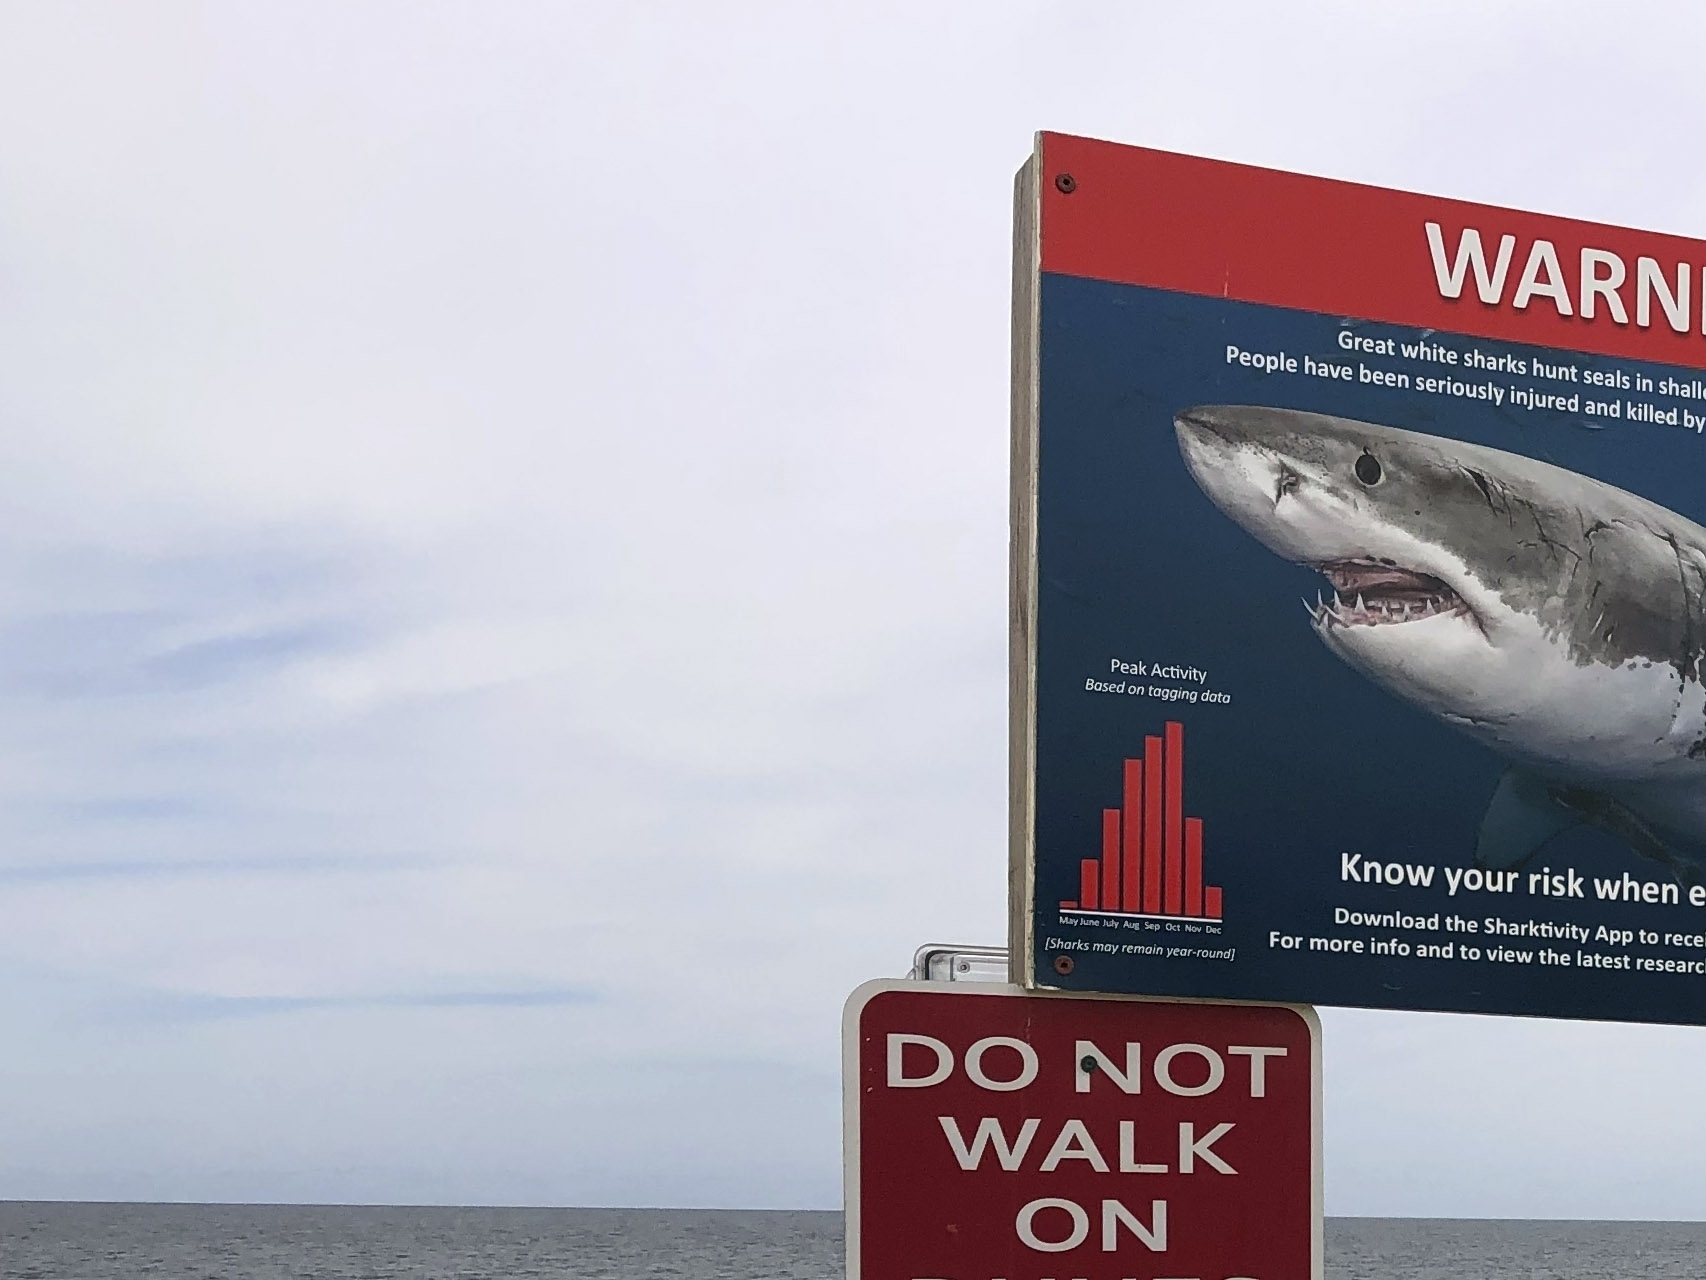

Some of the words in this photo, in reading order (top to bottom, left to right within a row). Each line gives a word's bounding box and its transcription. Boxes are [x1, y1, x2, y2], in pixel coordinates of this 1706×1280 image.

[1338, 330, 1395, 356] Great
[1400, 340, 1458, 364] white
[1464, 348, 1526, 375] sharks
[1532, 357, 1578, 382] hunt
[1583, 369, 1630, 389] seals
[1636, 373, 1653, 392] in
[1226, 345, 1297, 373] People
[1304, 355, 1352, 380] have
[1359, 363, 1409, 388] been
[1415, 375, 1505, 406] seriously
[1510, 385, 1578, 412] injured
[1584, 399, 1620, 418] and
[1627, 401, 1677, 425] killed
[1683, 408, 1706, 433] by
[1085, 678, 1125, 693] Based
[1127, 685, 1145, 695] on
[1148, 685, 1198, 703] tagging
[1200, 689, 1230, 703] data
[1111, 658, 1147, 675] Peak
[1150, 663, 1207, 684] Activity
[1341, 852, 1435, 887] Know
[1444, 867, 1518, 896] your
[1529, 866, 1584, 898] risk
[1593, 872, 1678, 904] when
[1059, 916, 1078, 926] May
[1080, 917, 1100, 927] June
[1102, 919, 1119, 929] July
[1123, 920, 1140, 931] Aug
[1144, 921, 1160, 932] Sep
[1165, 922, 1181, 932] Oct
[1185, 924, 1202, 933] Nov
[1205, 925, 1222, 935] Dec
[1335, 907, 1438, 930] Download
[1444, 914, 1478, 933] the
[1484, 917, 1590, 943] Sharktivity
[1595, 925, 1633, 946] App
[1638, 929, 1658, 944] to
[1044, 937, 1089, 951] [Sharks
[1092, 943, 1119, 955] may
[1121, 944, 1163, 955] remain
[1166, 947, 1235, 961] year-round]
[1270, 931, 1303, 949] For
[1309, 937, 1364, 953] more
[1371, 937, 1410, 956] info
[1416, 941, 1453, 958] and
[1459, 944, 1480, 960] to
[1486, 945, 1533, 963] view
[1538, 948, 1571, 966] the
[1577, 950, 1630, 969] latest
[886, 1033, 1039, 1091] DO
[1075, 1040, 1287, 1097] NOT
[937, 1116, 1238, 1174] WALK
[1015, 1197, 1167, 1252] ON
